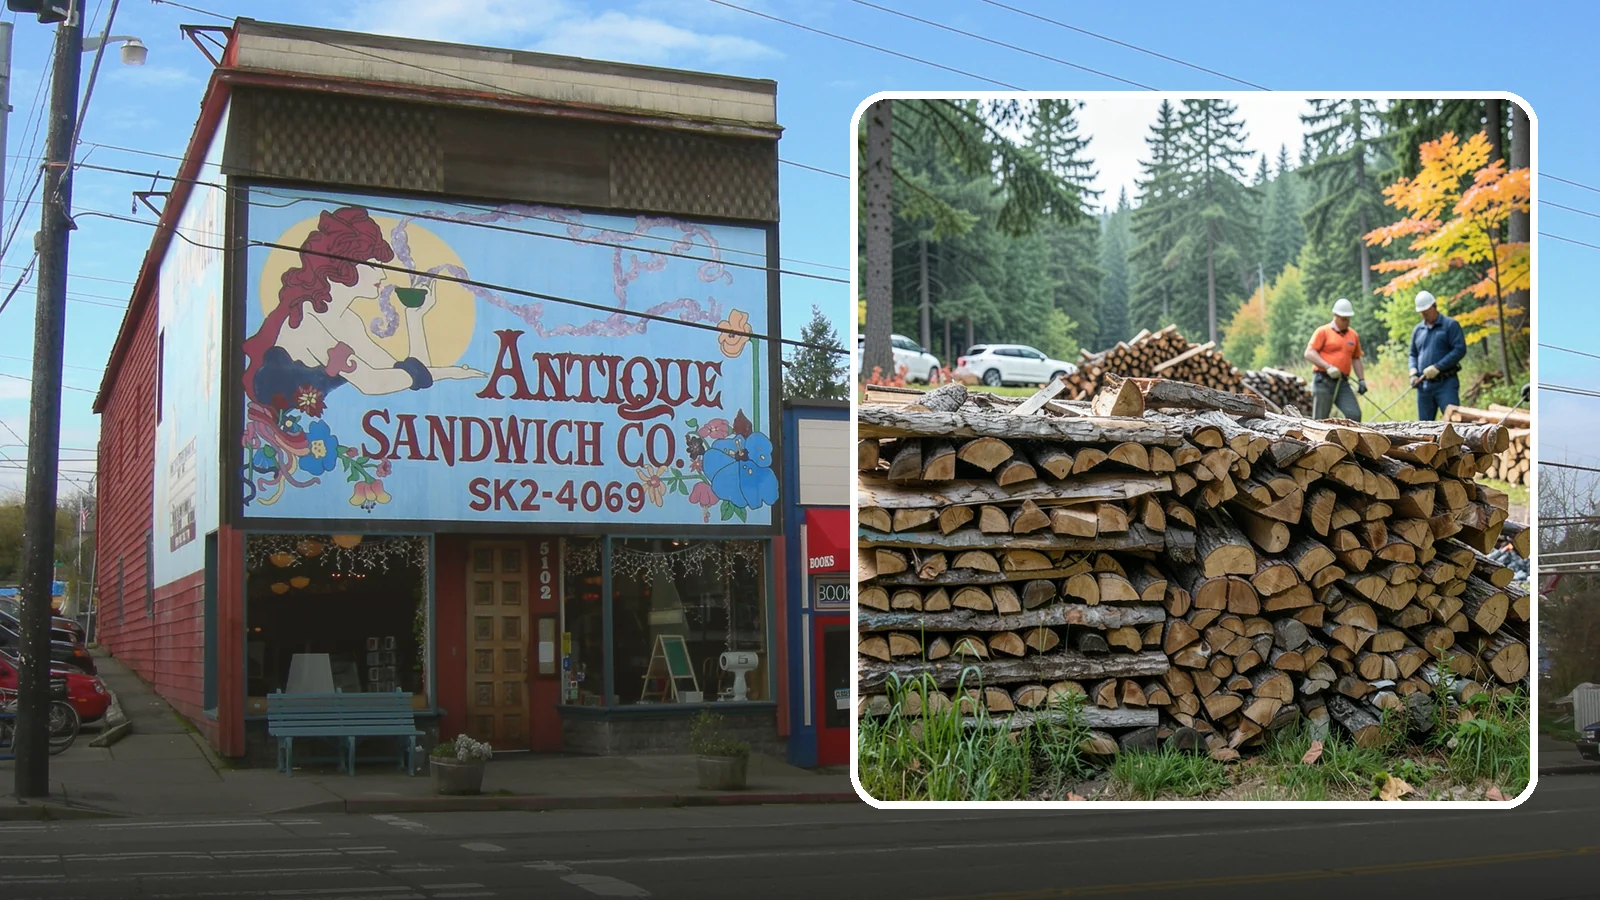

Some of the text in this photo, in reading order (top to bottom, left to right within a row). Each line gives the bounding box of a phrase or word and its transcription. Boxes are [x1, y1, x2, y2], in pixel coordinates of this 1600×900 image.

[476, 330, 723, 420] ANTIQUE
[361, 408, 685, 468] SANDWICH CO.
[468, 478, 646, 513] SK2-4069
[540, 541, 551, 600] 5102
[809, 555, 835, 569] BOOKS
